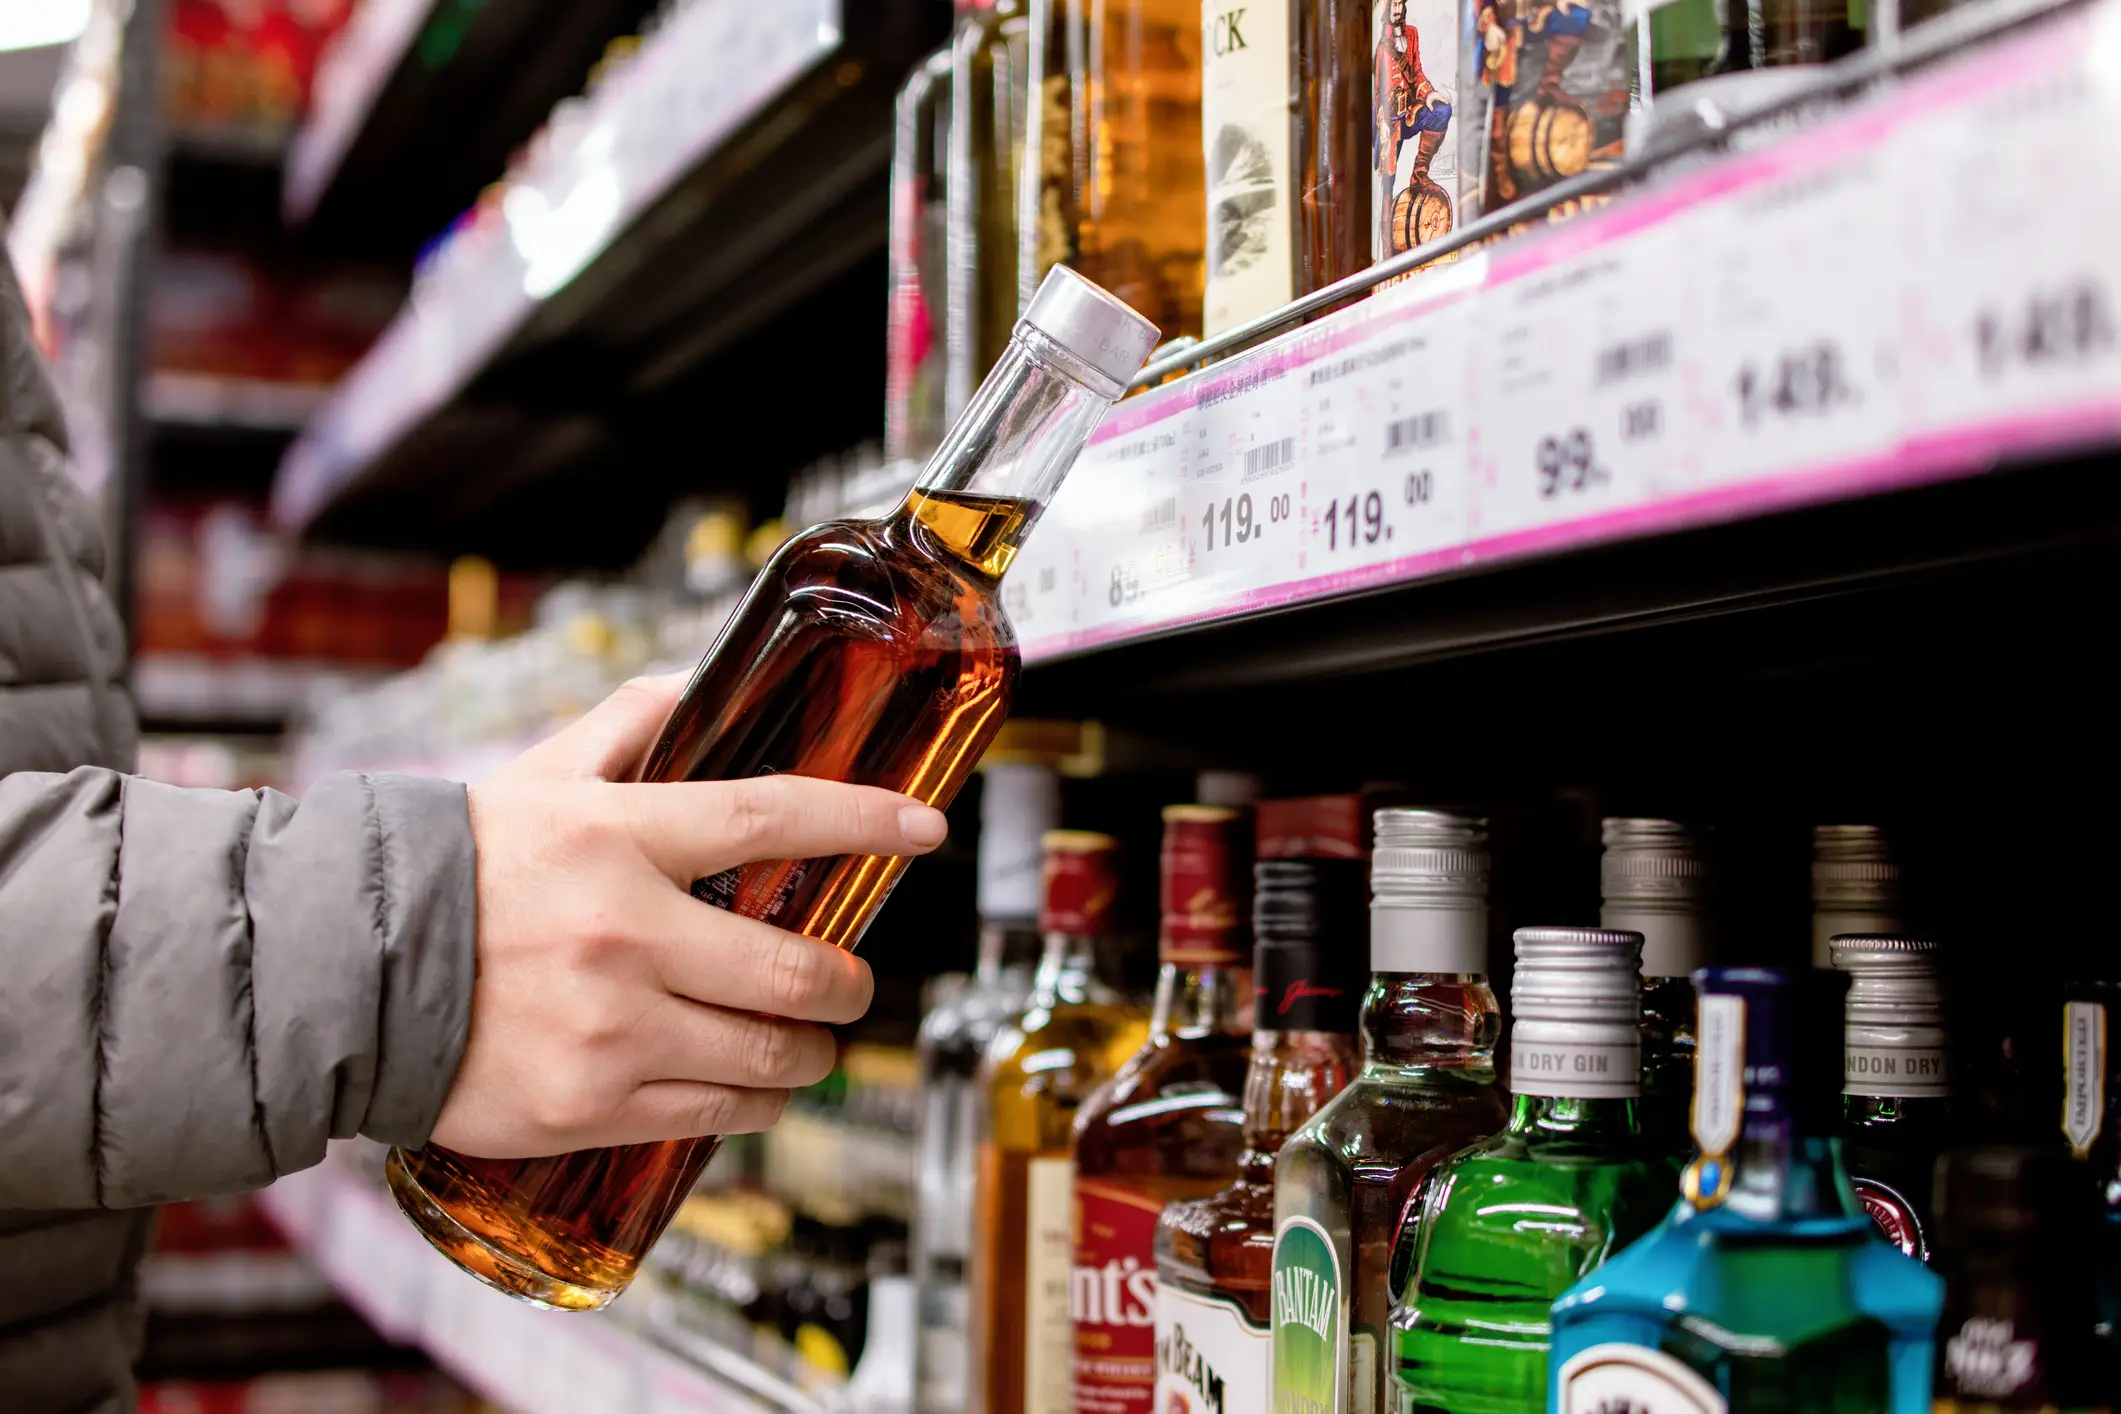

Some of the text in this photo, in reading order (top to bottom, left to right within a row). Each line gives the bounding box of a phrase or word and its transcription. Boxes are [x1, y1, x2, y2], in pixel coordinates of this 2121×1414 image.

[1202, 492, 1262, 552] 119.
[1270, 492, 1291, 524] 00
[1324, 488, 1393, 551] 119.
[1405, 467, 1434, 507] 00
[1530, 1053, 1565, 1072] DRY
[1573, 1054, 1608, 1073] GIN
[1905, 1057, 1941, 1075] DRY
[1274, 1265, 1336, 1343] BANTAM
